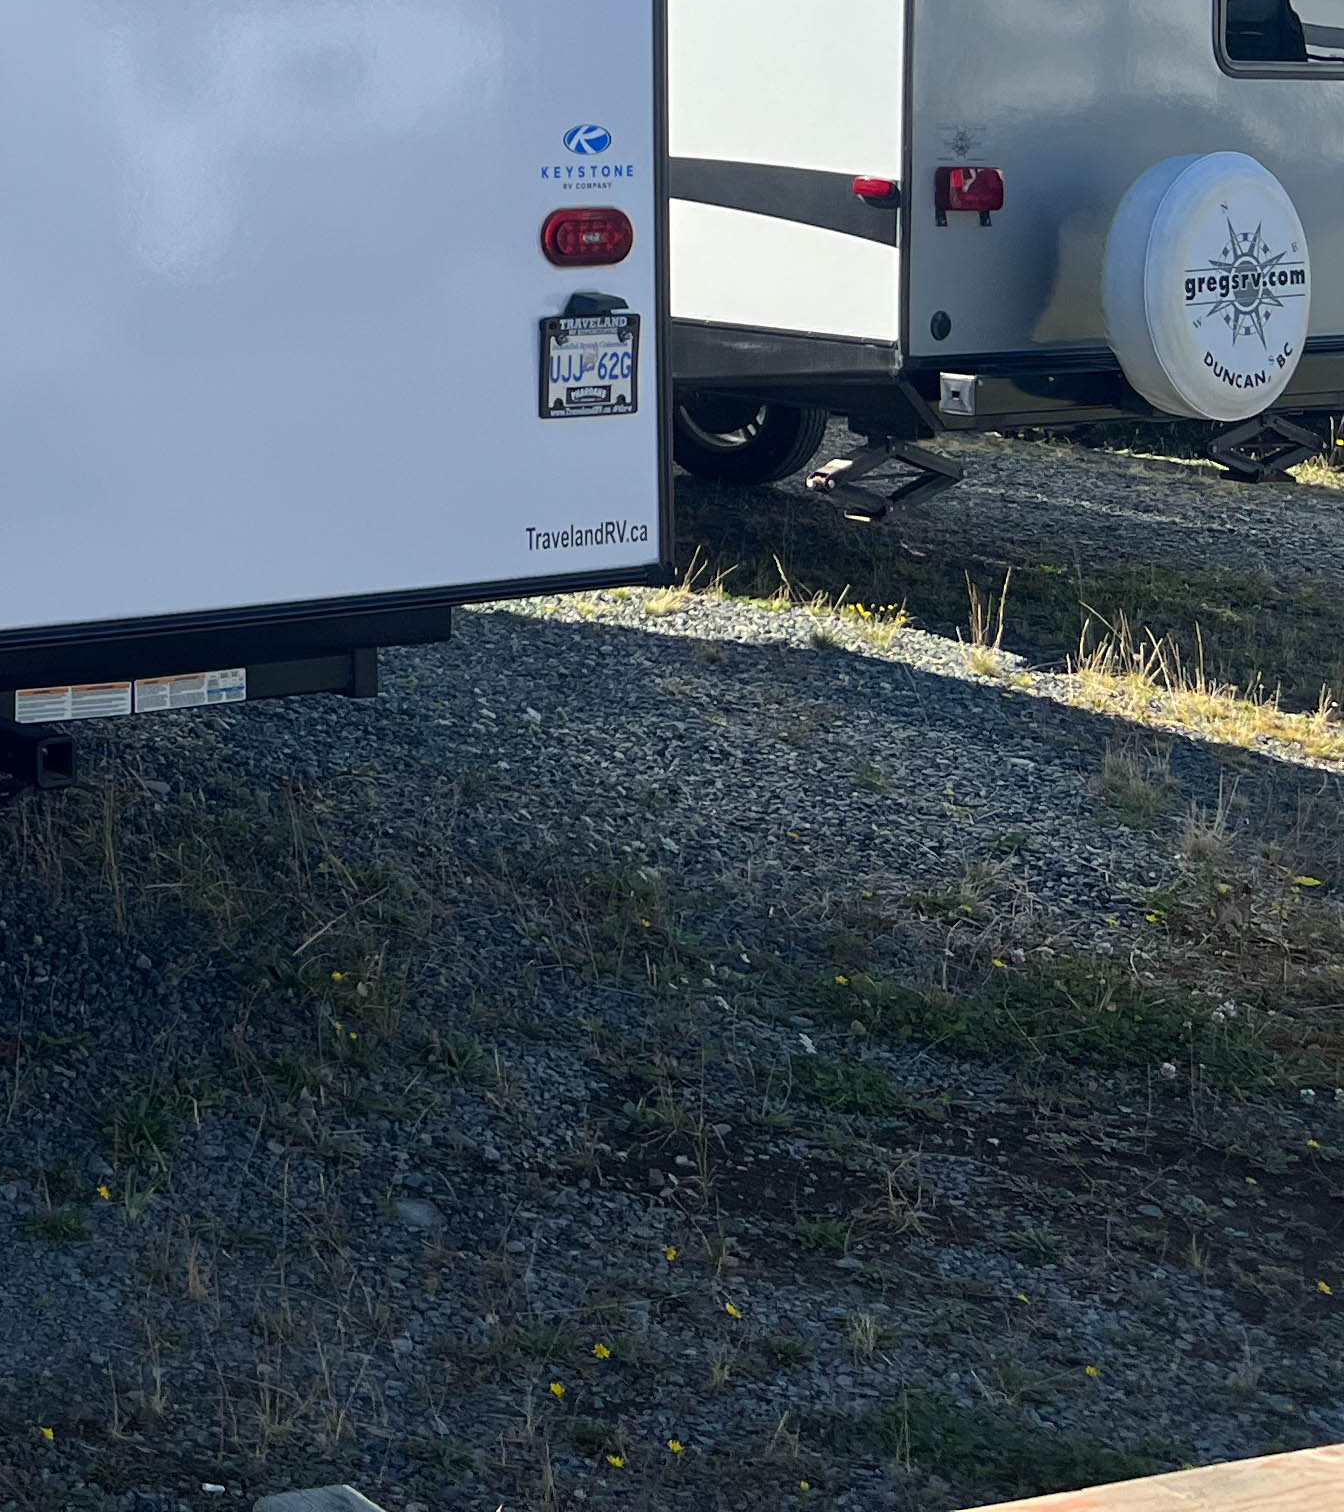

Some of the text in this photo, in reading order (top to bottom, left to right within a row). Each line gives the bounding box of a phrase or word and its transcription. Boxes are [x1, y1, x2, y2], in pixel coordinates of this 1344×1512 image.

[541, 164, 634, 179] KEYSTONE
[563, 182, 612, 190] RV COMPANY
[1185, 268, 1305, 301] gregsrv.com
[559, 316, 628, 330] TRAVELAND
[1277, 342, 1293, 368] BC
[526, 519, 648, 551] TravelandRV.ca
